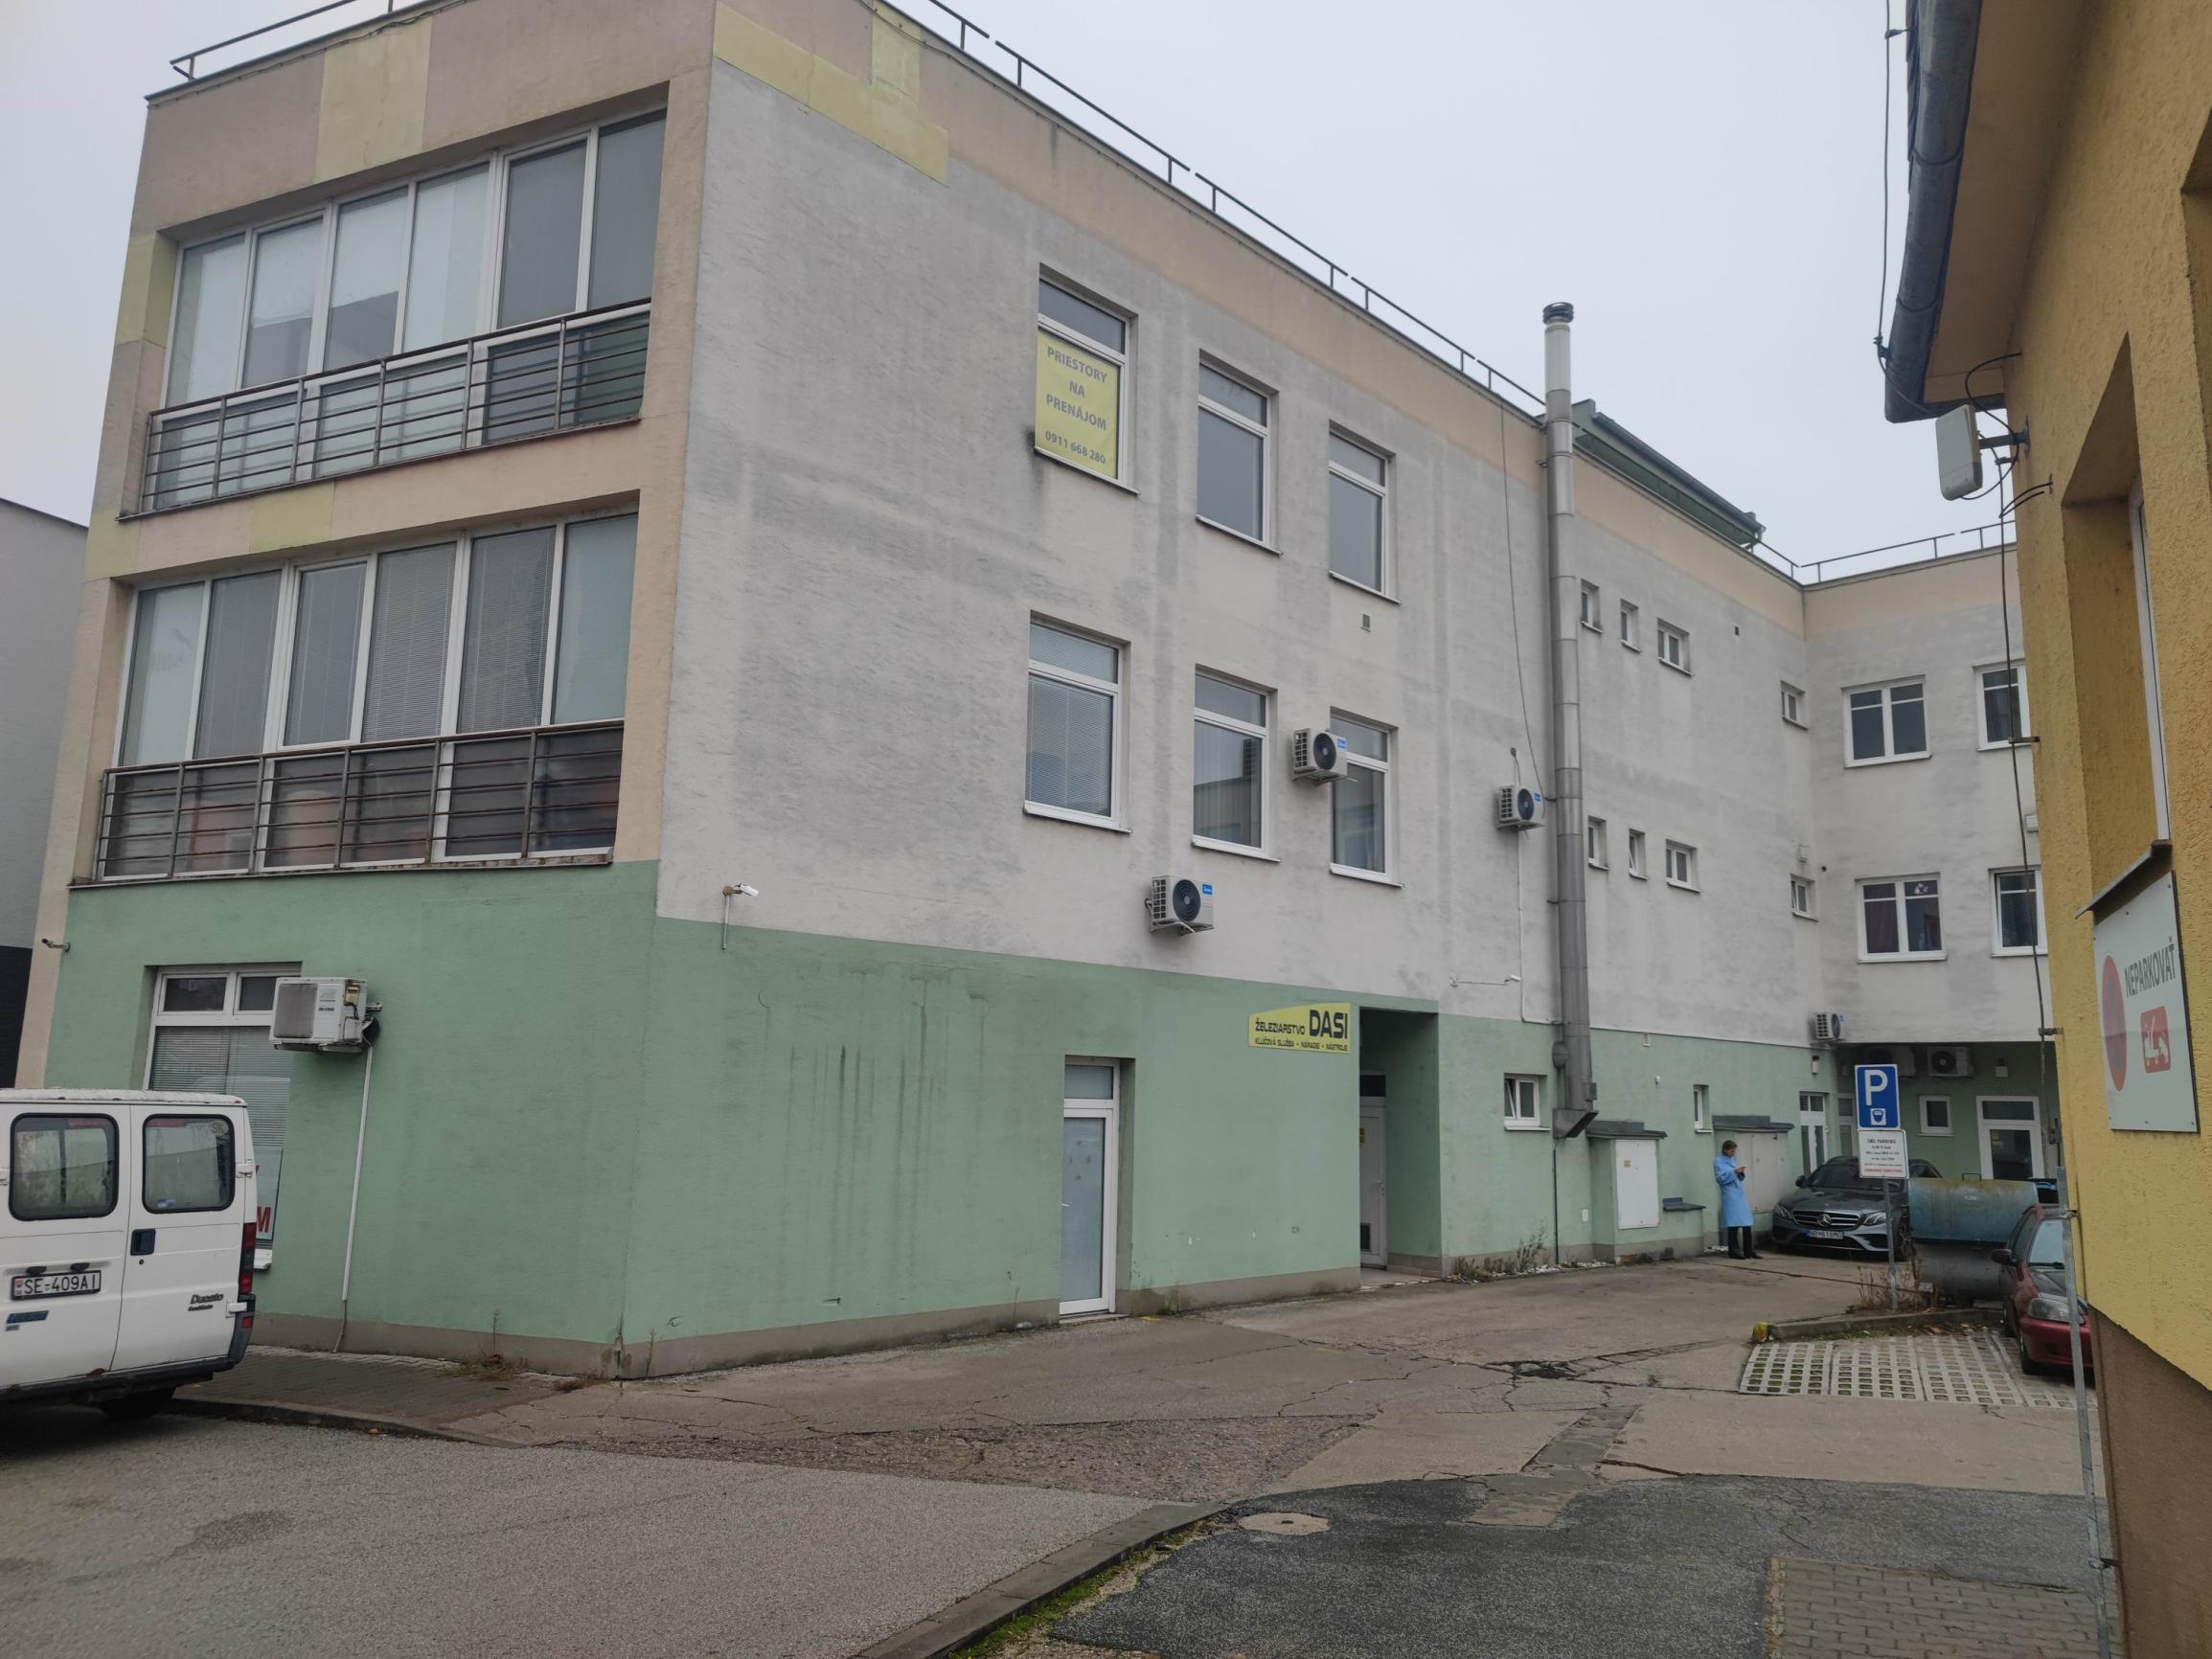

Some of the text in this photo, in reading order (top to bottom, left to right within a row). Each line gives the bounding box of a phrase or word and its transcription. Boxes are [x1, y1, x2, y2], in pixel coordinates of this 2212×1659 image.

[1047, 346, 1107, 382] PRIESTORY
[1069, 380, 1085, 398] NA
[1046, 394, 1106, 430] PRENÁJOM
[1045, 431, 1068, 448] 0911
[1071, 442, 1087, 457] 668
[2125, 937, 2176, 998] NEPARKOVAŤ
[1255, 1009, 1348, 1039] ŽELEZIARSTVO DASI
[1863, 1069, 1888, 1106] P
